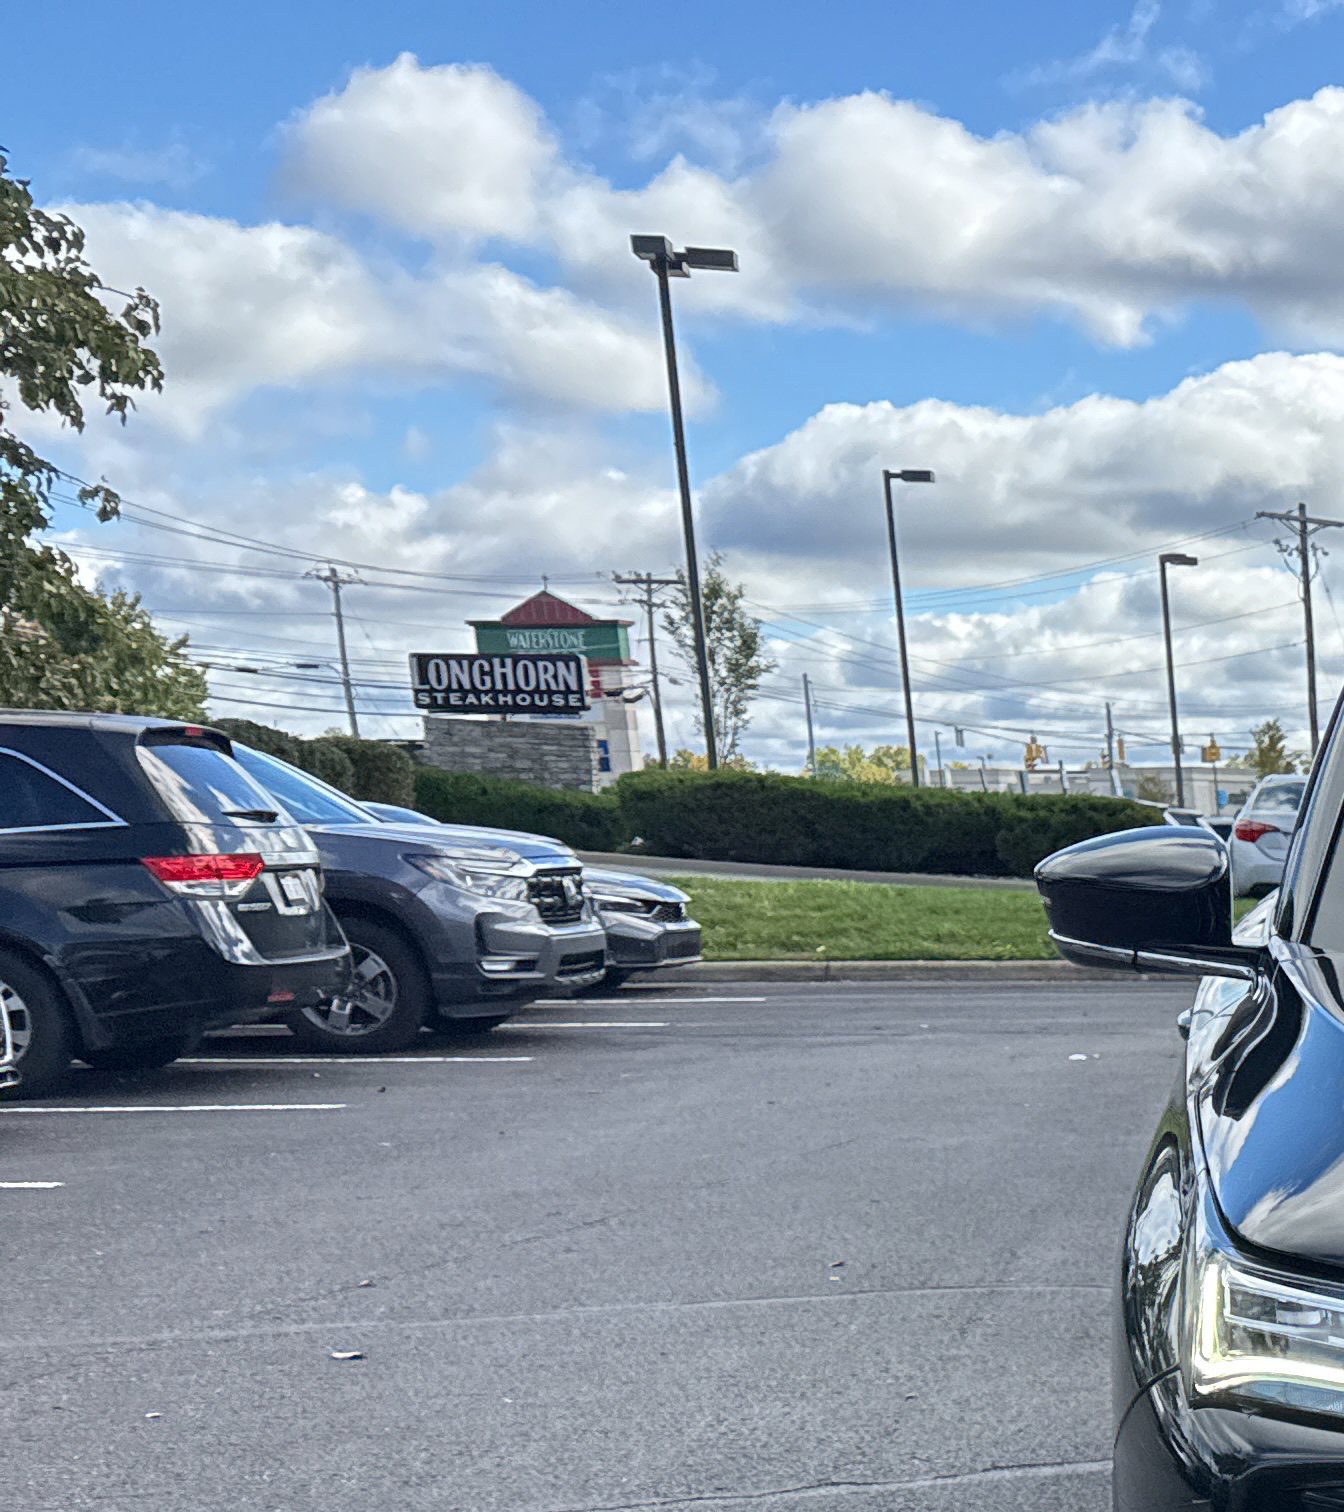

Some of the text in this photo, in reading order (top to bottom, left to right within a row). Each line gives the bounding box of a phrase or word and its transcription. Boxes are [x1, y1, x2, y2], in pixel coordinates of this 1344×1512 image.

[507, 629, 585, 649] WATERSTONE
[411, 657, 579, 691] LONGHORN
[417, 692, 582, 706] STEAKHOUSE
